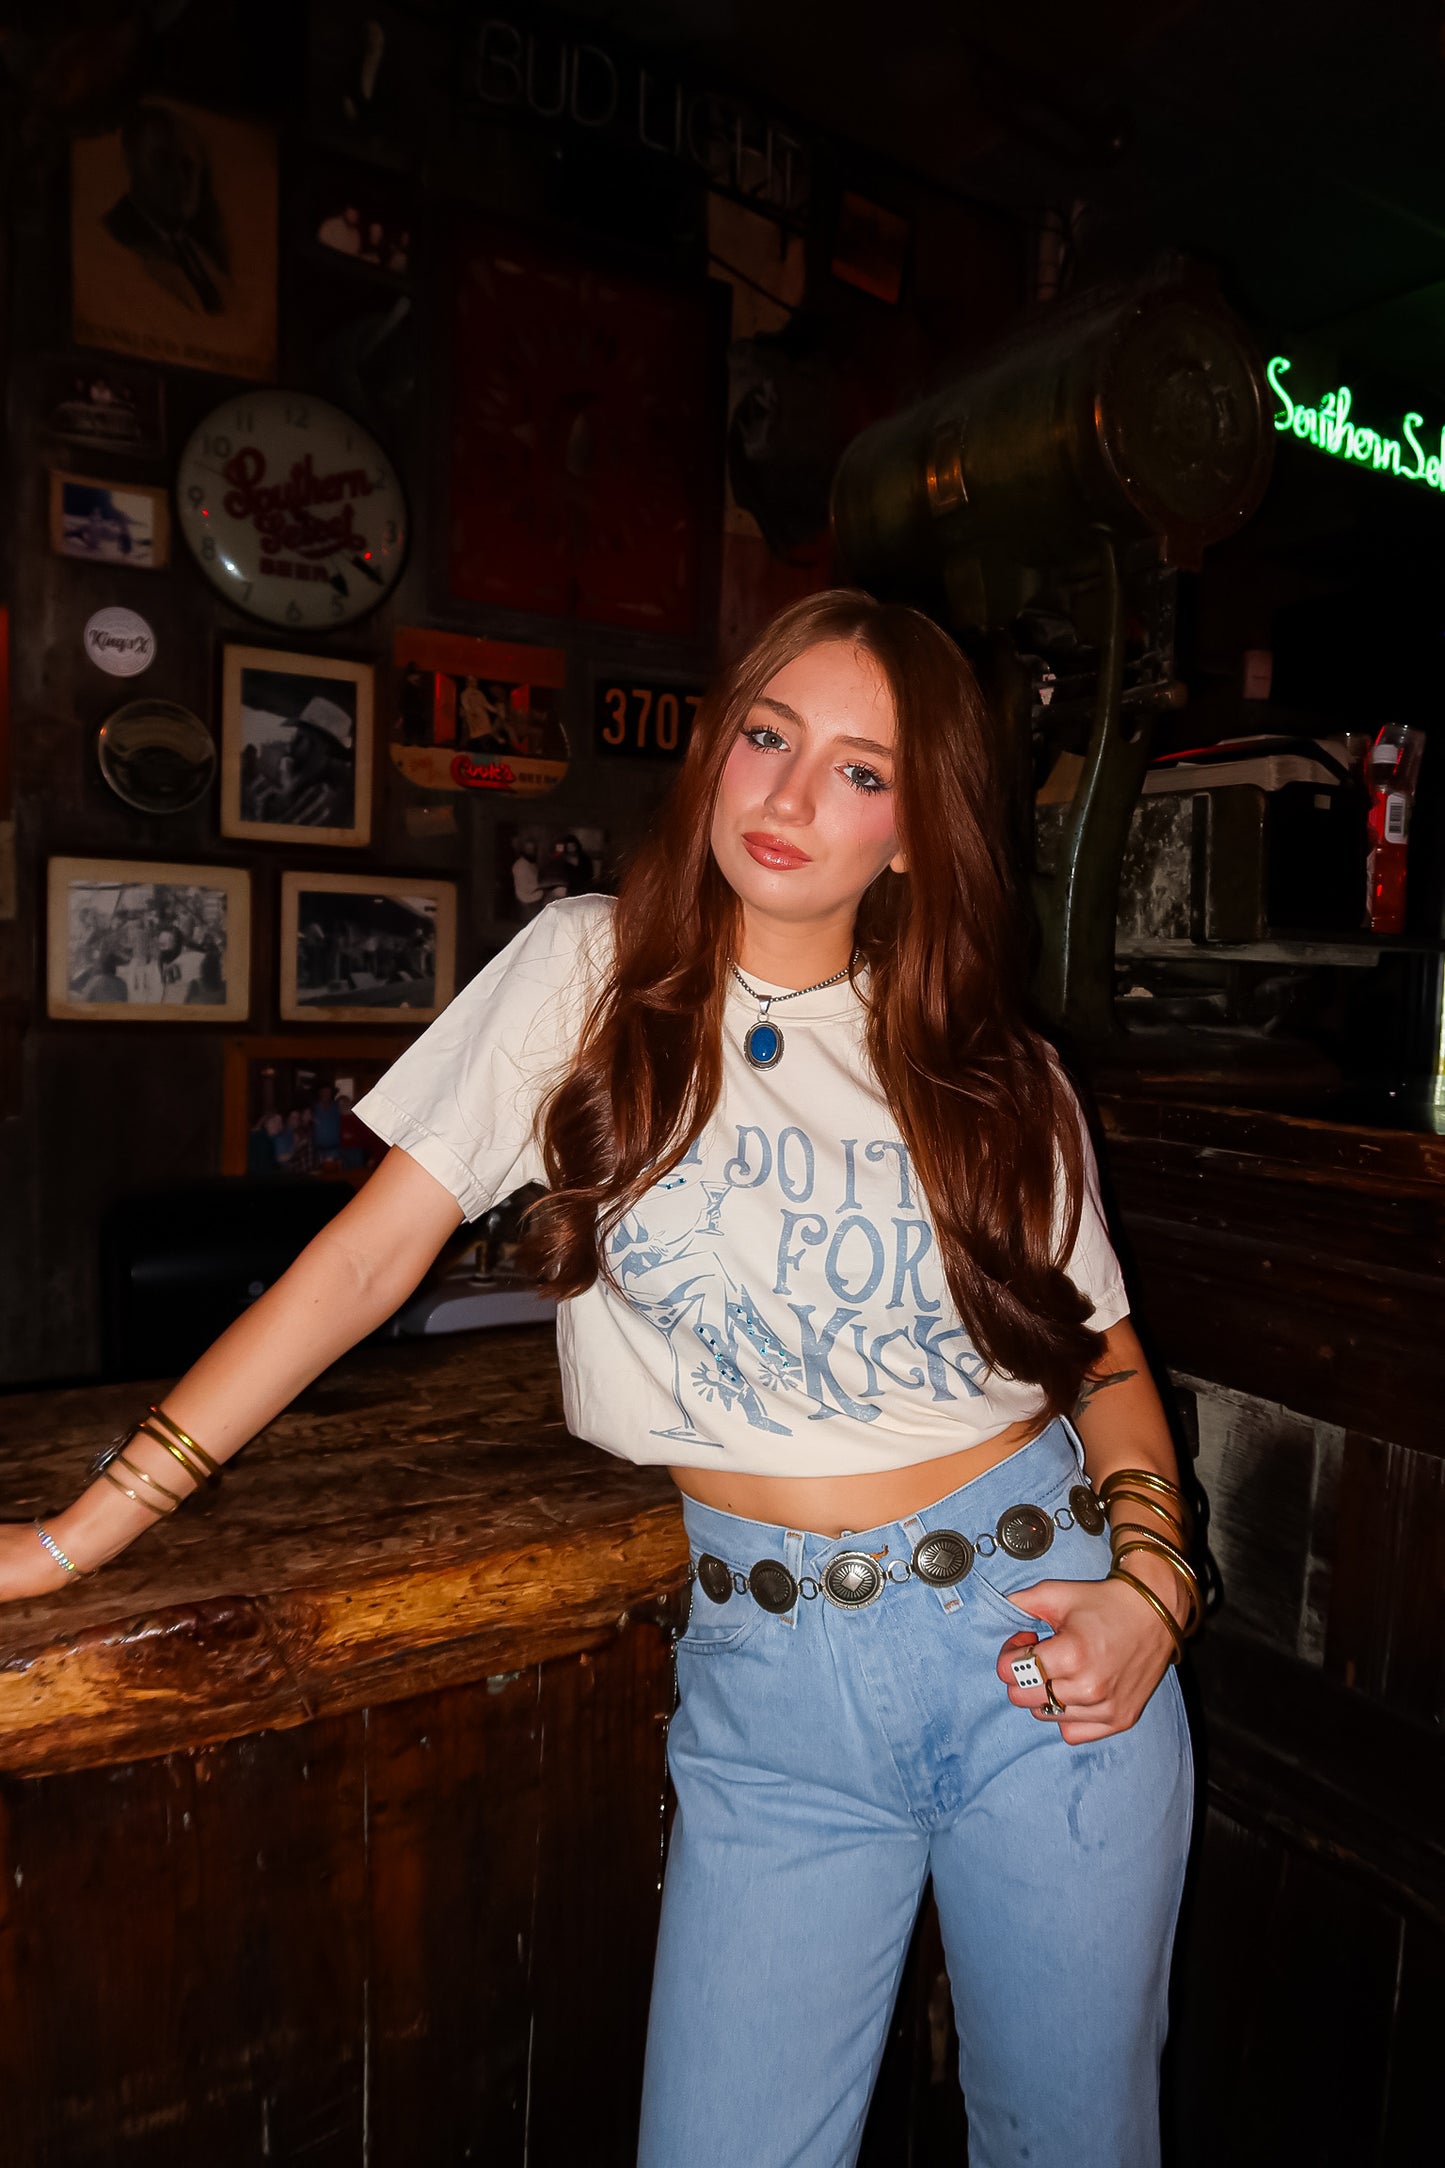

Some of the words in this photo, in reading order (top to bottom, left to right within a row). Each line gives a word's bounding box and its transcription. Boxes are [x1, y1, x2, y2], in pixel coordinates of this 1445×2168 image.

[476, 18, 619, 127] BUD
[1266, 355, 1400, 476] Southern
[723, 1124, 815, 1204] DO
[835, 1138, 917, 1214] IT
[772, 1208, 941, 1313] FOR
